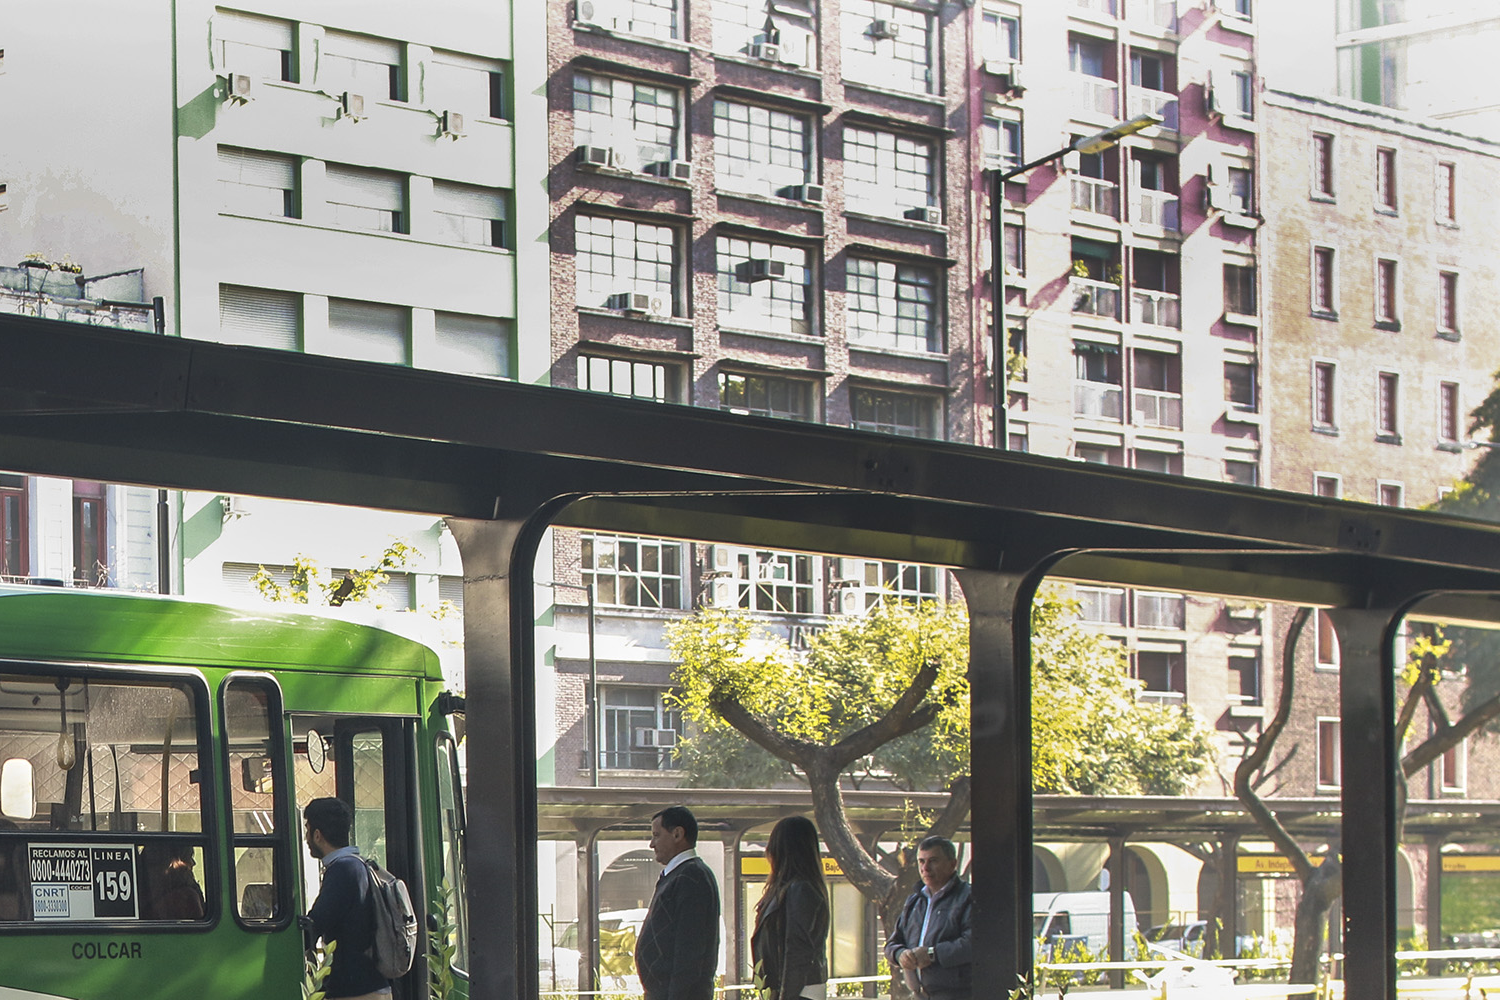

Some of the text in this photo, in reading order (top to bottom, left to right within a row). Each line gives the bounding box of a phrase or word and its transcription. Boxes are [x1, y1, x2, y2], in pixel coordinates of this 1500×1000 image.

[33, 850, 88, 858] RECLAMOS AL
[31, 859, 90, 881] 0800-4440273
[35, 888, 65, 897] CNRT
[96, 871, 131, 901] 159
[72, 942, 142, 959] COLCAR
